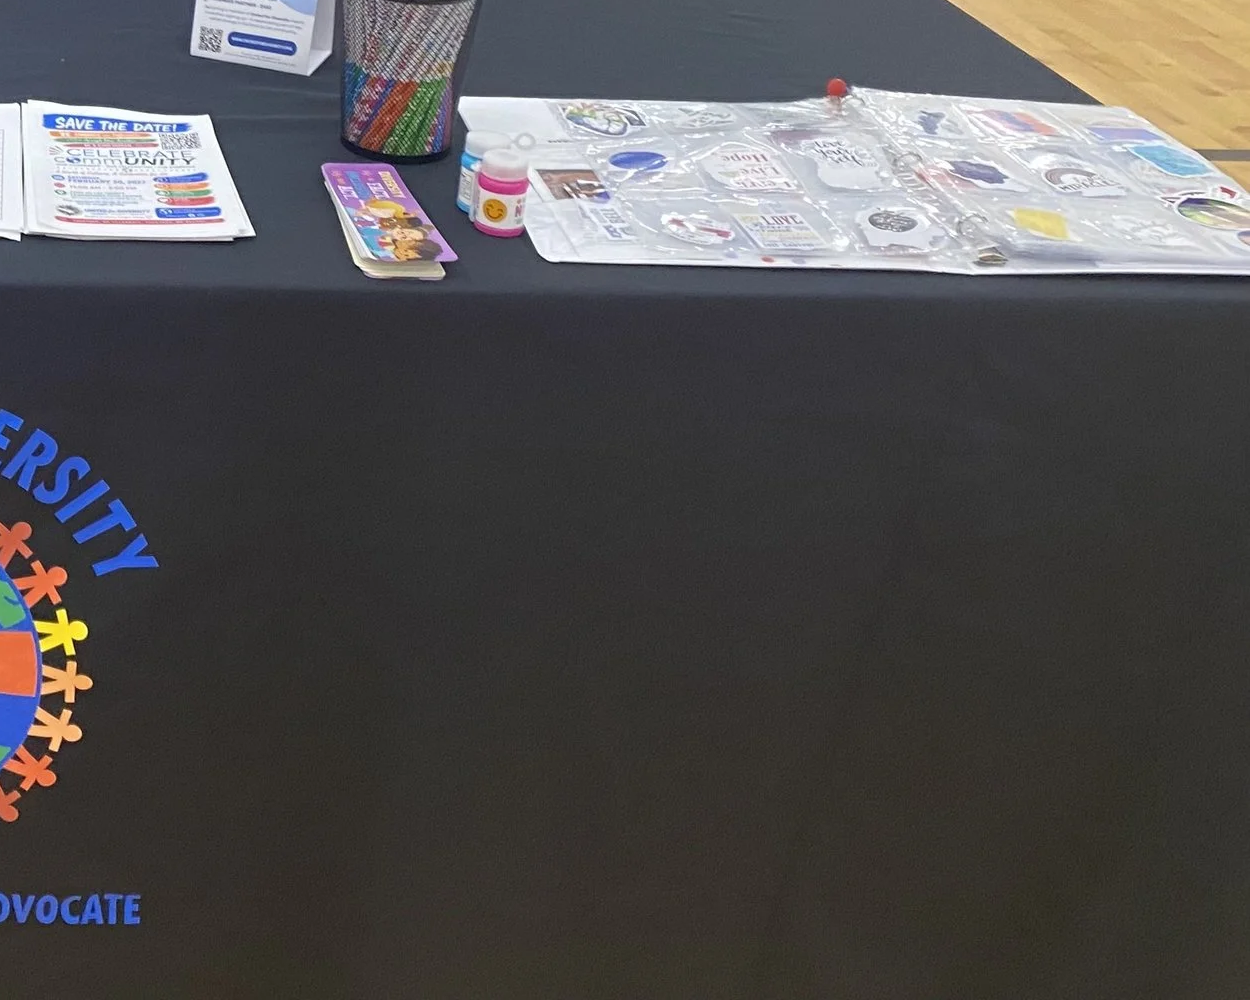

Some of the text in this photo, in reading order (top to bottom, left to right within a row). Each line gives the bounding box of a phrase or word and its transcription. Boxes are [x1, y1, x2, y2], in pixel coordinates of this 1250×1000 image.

[54, 116, 178, 132] SAVE THE DATE!
[66, 149, 193, 158] CELEBRATE
[721, 152, 768, 163] Hope
[760, 214, 804, 225] LOVE
